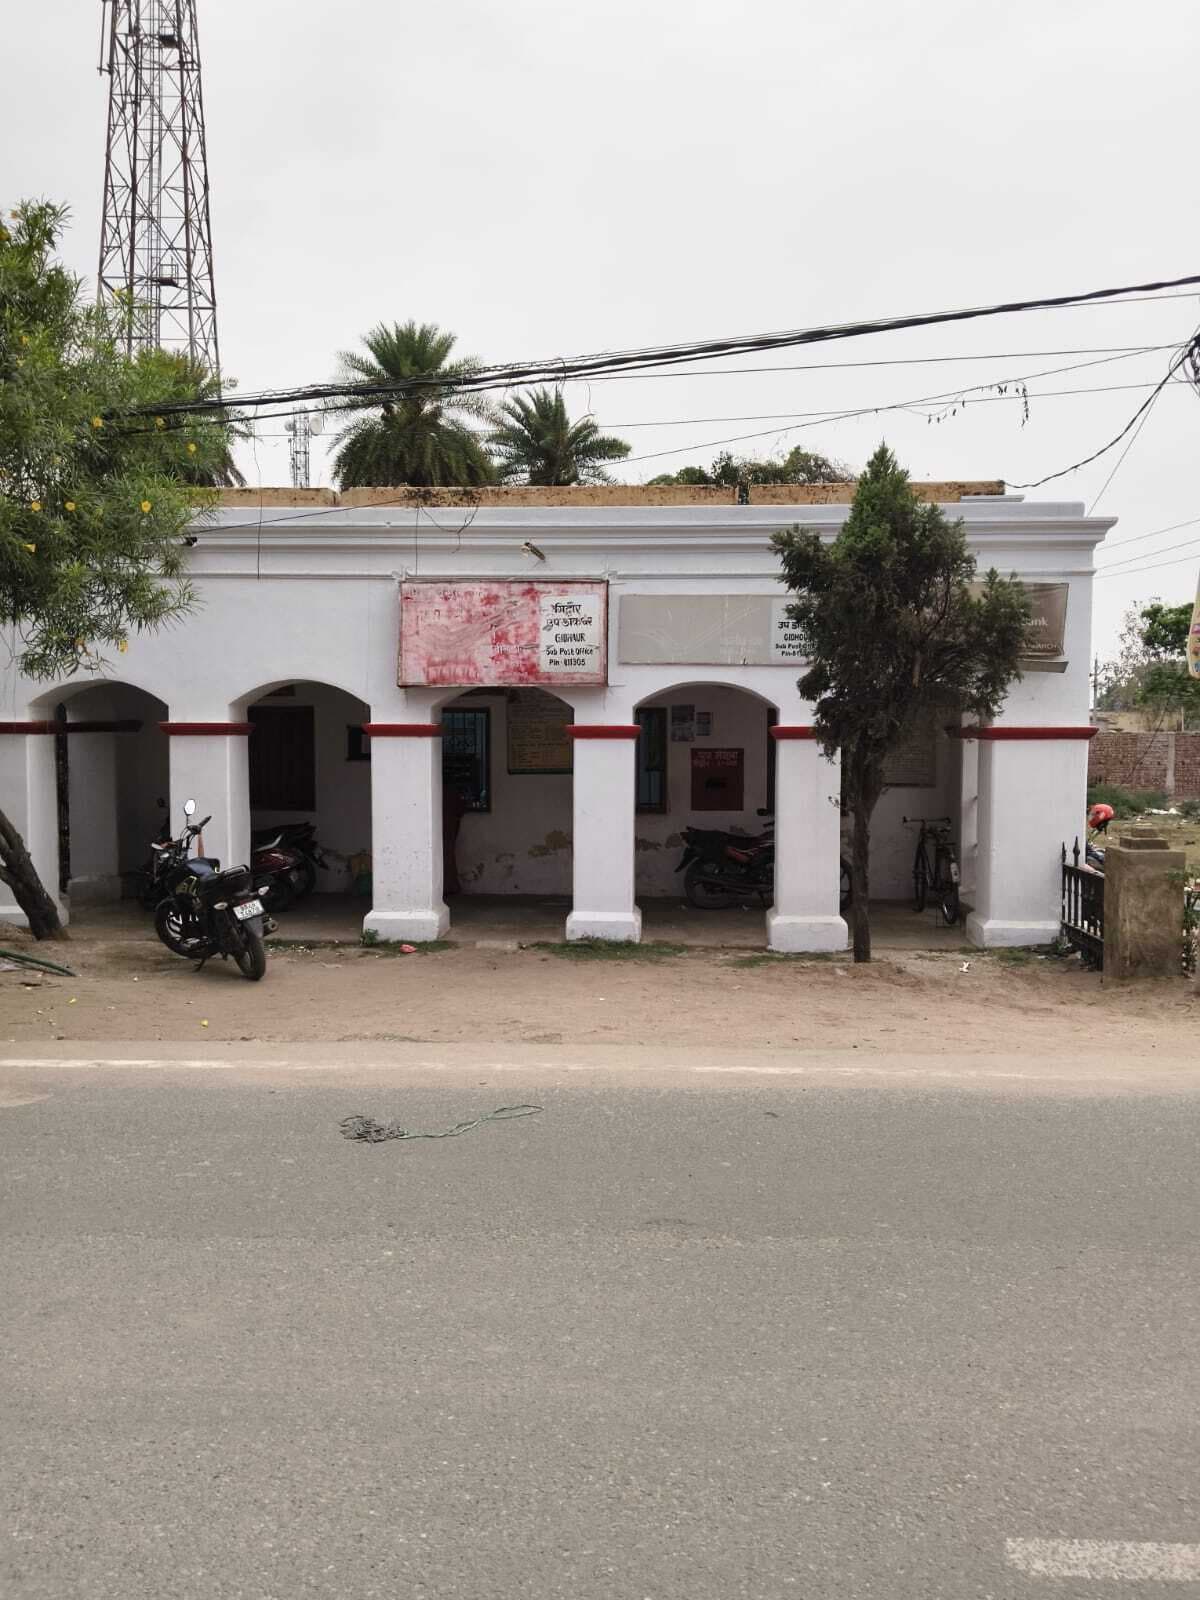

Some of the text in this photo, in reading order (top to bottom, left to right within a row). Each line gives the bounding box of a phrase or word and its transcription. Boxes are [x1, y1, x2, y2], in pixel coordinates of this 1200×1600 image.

[546, 647, 593, 655] Sub Post Office
